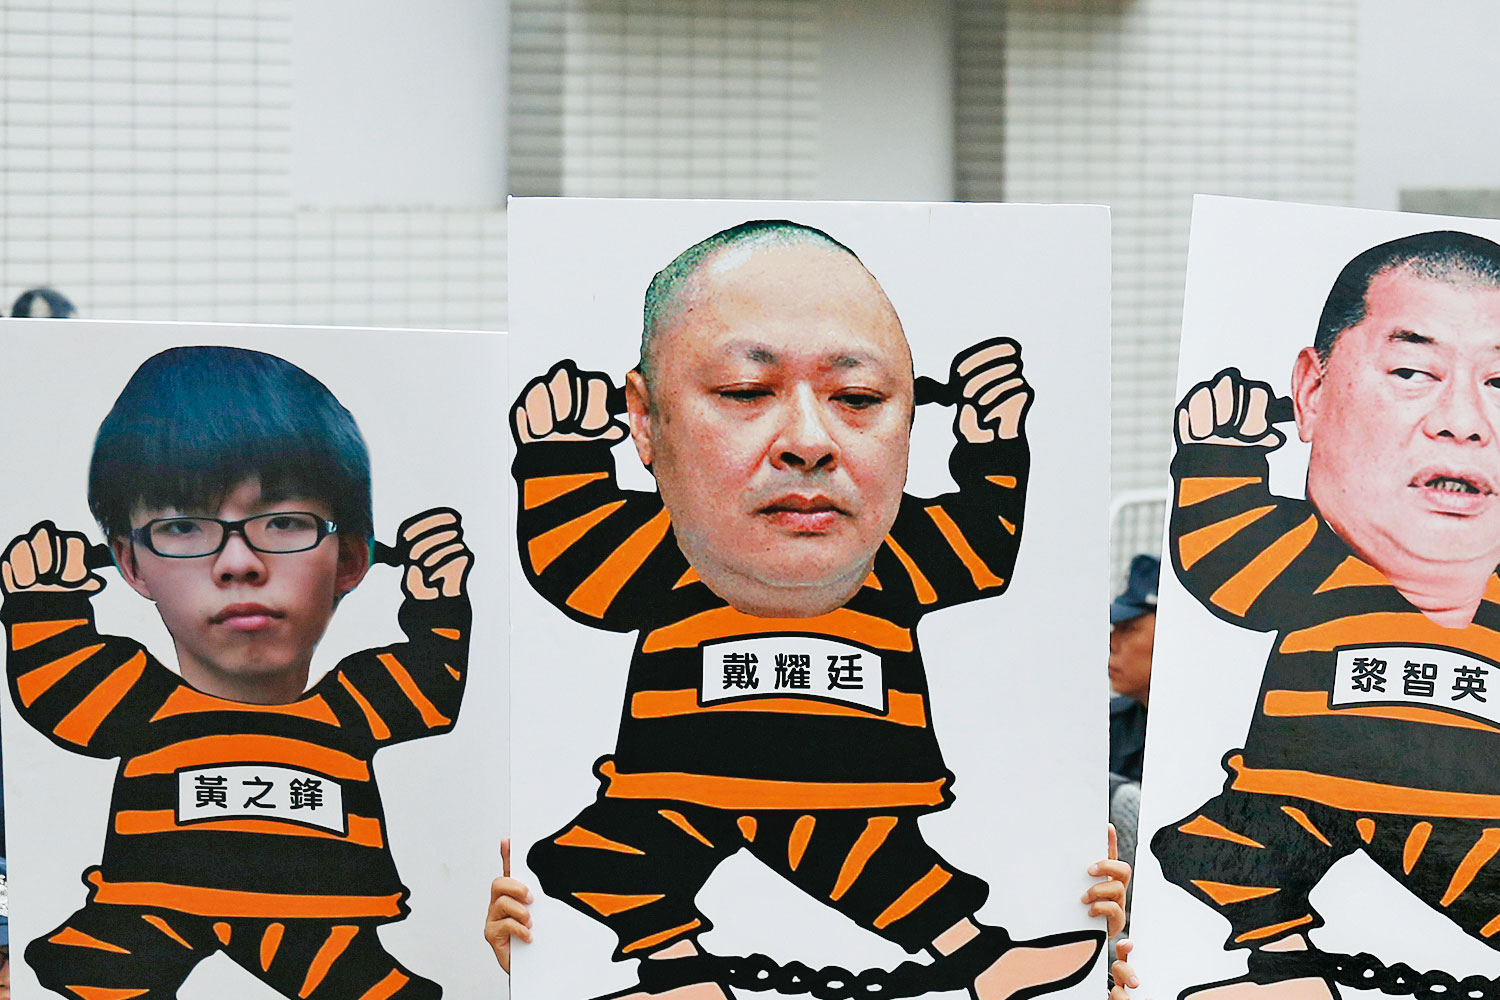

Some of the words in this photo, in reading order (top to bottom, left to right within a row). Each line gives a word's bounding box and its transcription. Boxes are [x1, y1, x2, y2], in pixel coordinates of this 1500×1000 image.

[722, 652, 864, 690] 戴耀廷
[1351, 657, 1489, 703] 黎智英
[194, 775, 324, 811] 黃之鋒
